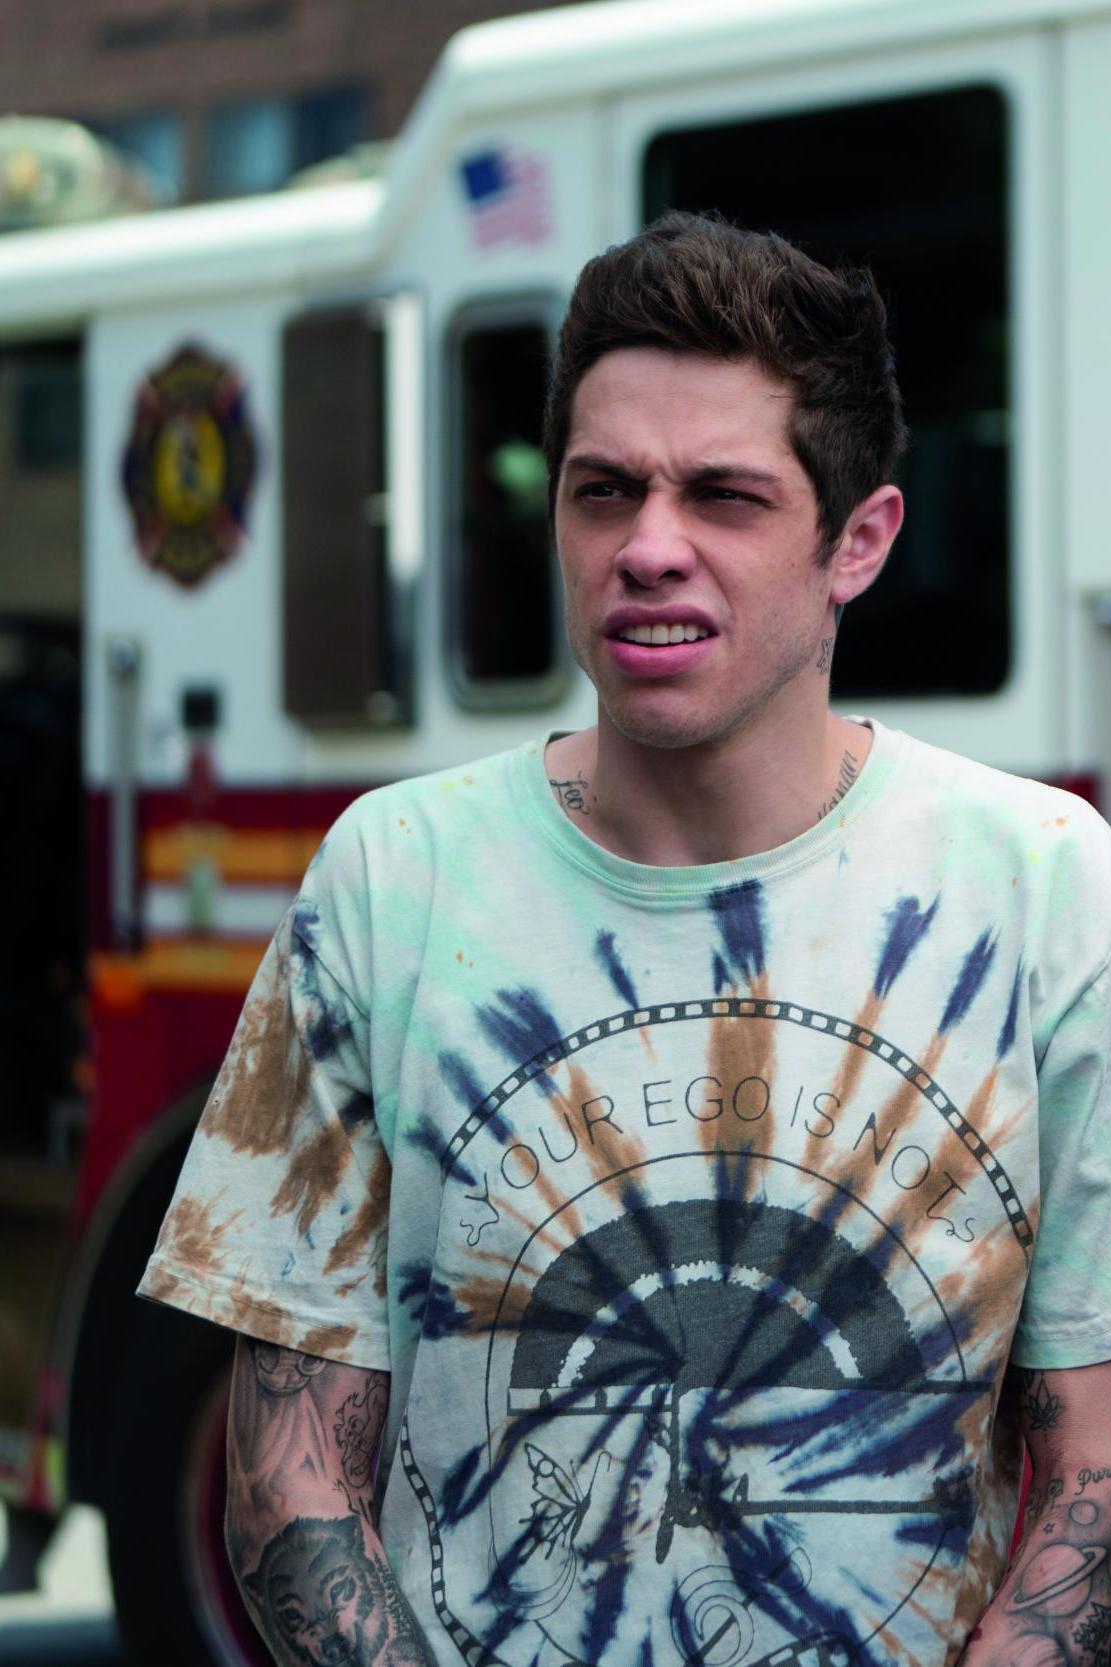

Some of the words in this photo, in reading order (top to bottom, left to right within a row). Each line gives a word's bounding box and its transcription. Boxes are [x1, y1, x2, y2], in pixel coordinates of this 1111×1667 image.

[461, 1095, 623, 1240] YOUR
[643, 1075, 770, 1128] EGO
[790, 1085, 841, 1138] IS
[852, 1112, 971, 1236] NOT
